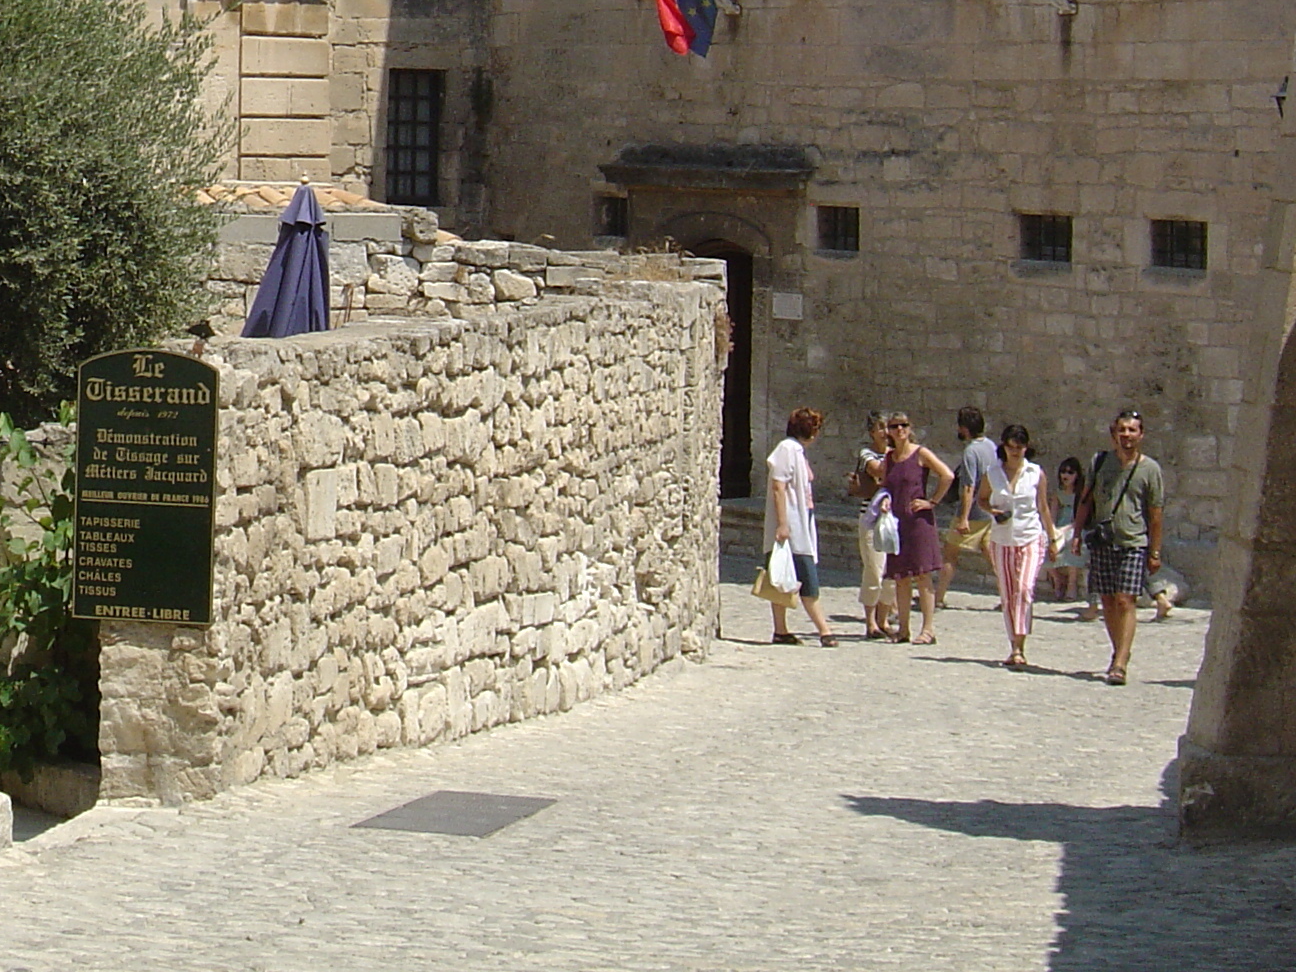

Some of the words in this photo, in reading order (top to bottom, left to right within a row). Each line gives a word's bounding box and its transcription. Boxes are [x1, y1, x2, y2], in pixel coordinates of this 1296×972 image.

[132, 354, 164, 378] Le
[86, 377, 210, 405] Tisserand
[117, 407, 150, 420] depuis
[97, 428, 197, 446] Démonstration
[93, 446, 107, 460] de
[115, 447, 168, 465] Tissage
[176, 453, 200, 464] sur
[85, 463, 137, 479] Métiers
[145, 466, 208, 484] Jacquard
[117, 491, 148, 501] OUVRIER
[150, 493, 160, 501] DE
[162, 493, 190, 503] FRANCE
[80, 516, 141, 529] TAPISSERIE
[80, 531, 135, 543] TABLEAUX
[80, 542, 117, 553] TISSES
[78, 556, 133, 569] CRAVATES
[78, 569, 122, 582] CHÂLES
[78, 585, 116, 596] TISSUS
